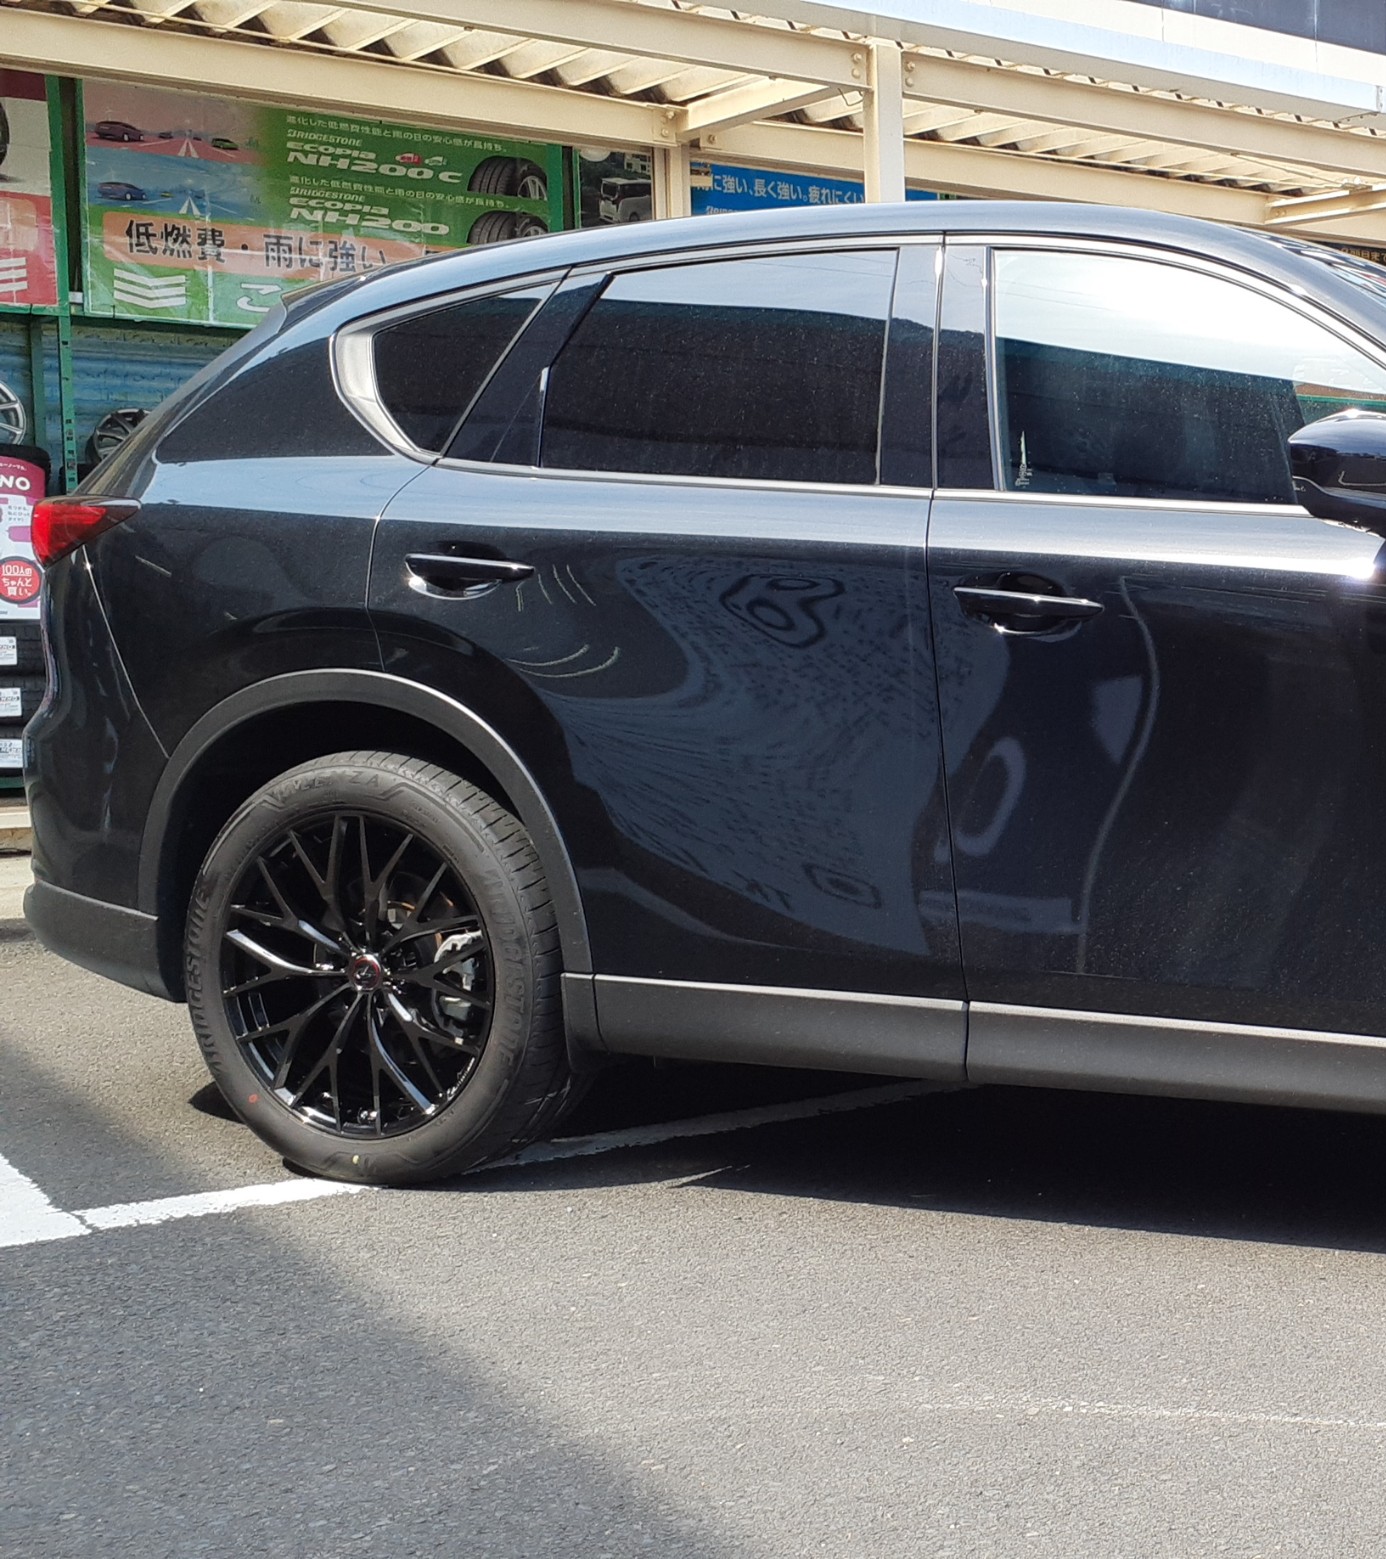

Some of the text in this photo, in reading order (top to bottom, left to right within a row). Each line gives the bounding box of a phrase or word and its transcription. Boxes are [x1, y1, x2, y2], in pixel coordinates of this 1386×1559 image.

[287, 129, 363, 147] BRIDGESTONE
[287, 151, 434, 180] NH200
[289, 186, 366, 203] BRIDGESTONE
[290, 207, 450, 236] NH200
